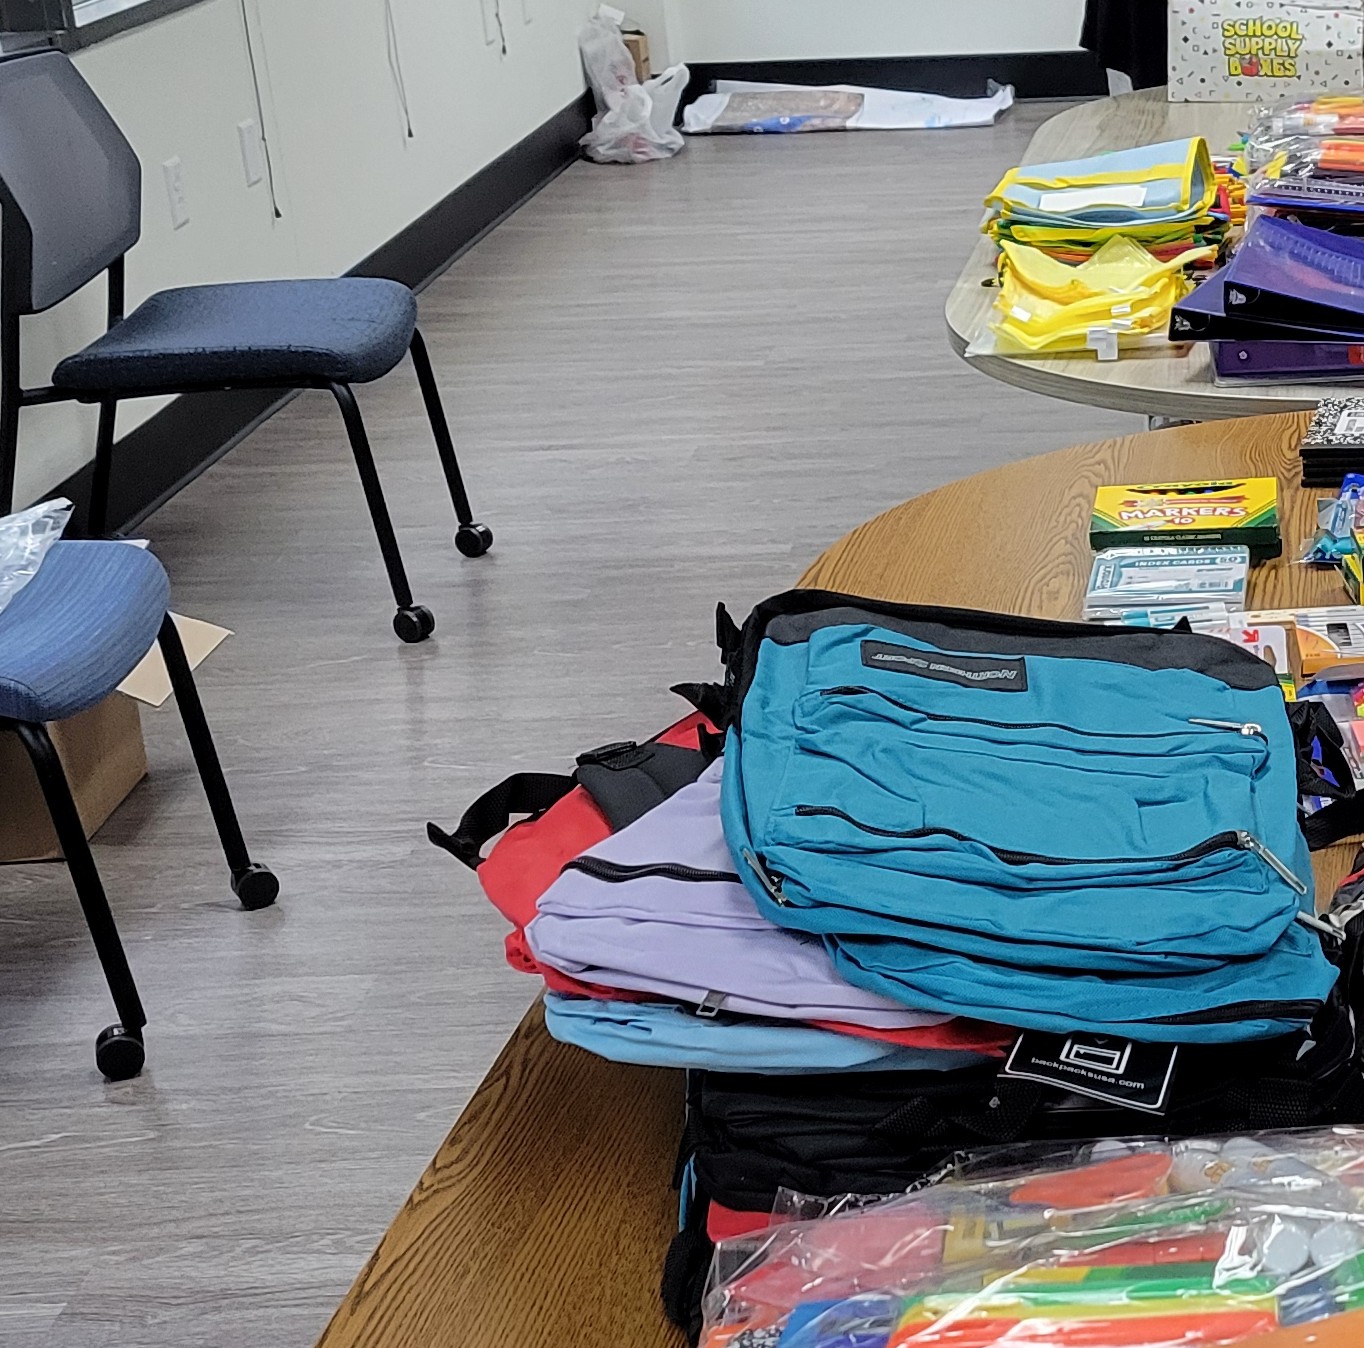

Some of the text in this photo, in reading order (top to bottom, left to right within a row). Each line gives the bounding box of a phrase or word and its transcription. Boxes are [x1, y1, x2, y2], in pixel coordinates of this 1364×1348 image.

[1221, 18, 1304, 39] SCHOOL
[1222, 37, 1302, 58] SUPPLY
[1228, 56, 1297, 77] BOXES
[1120, 507, 1248, 520] MARKERS
[1172, 517, 1194, 525] 10
[1172, 558, 1211, 566] CARDS
[1031, 1056, 1145, 1090] backpacksusa.com
